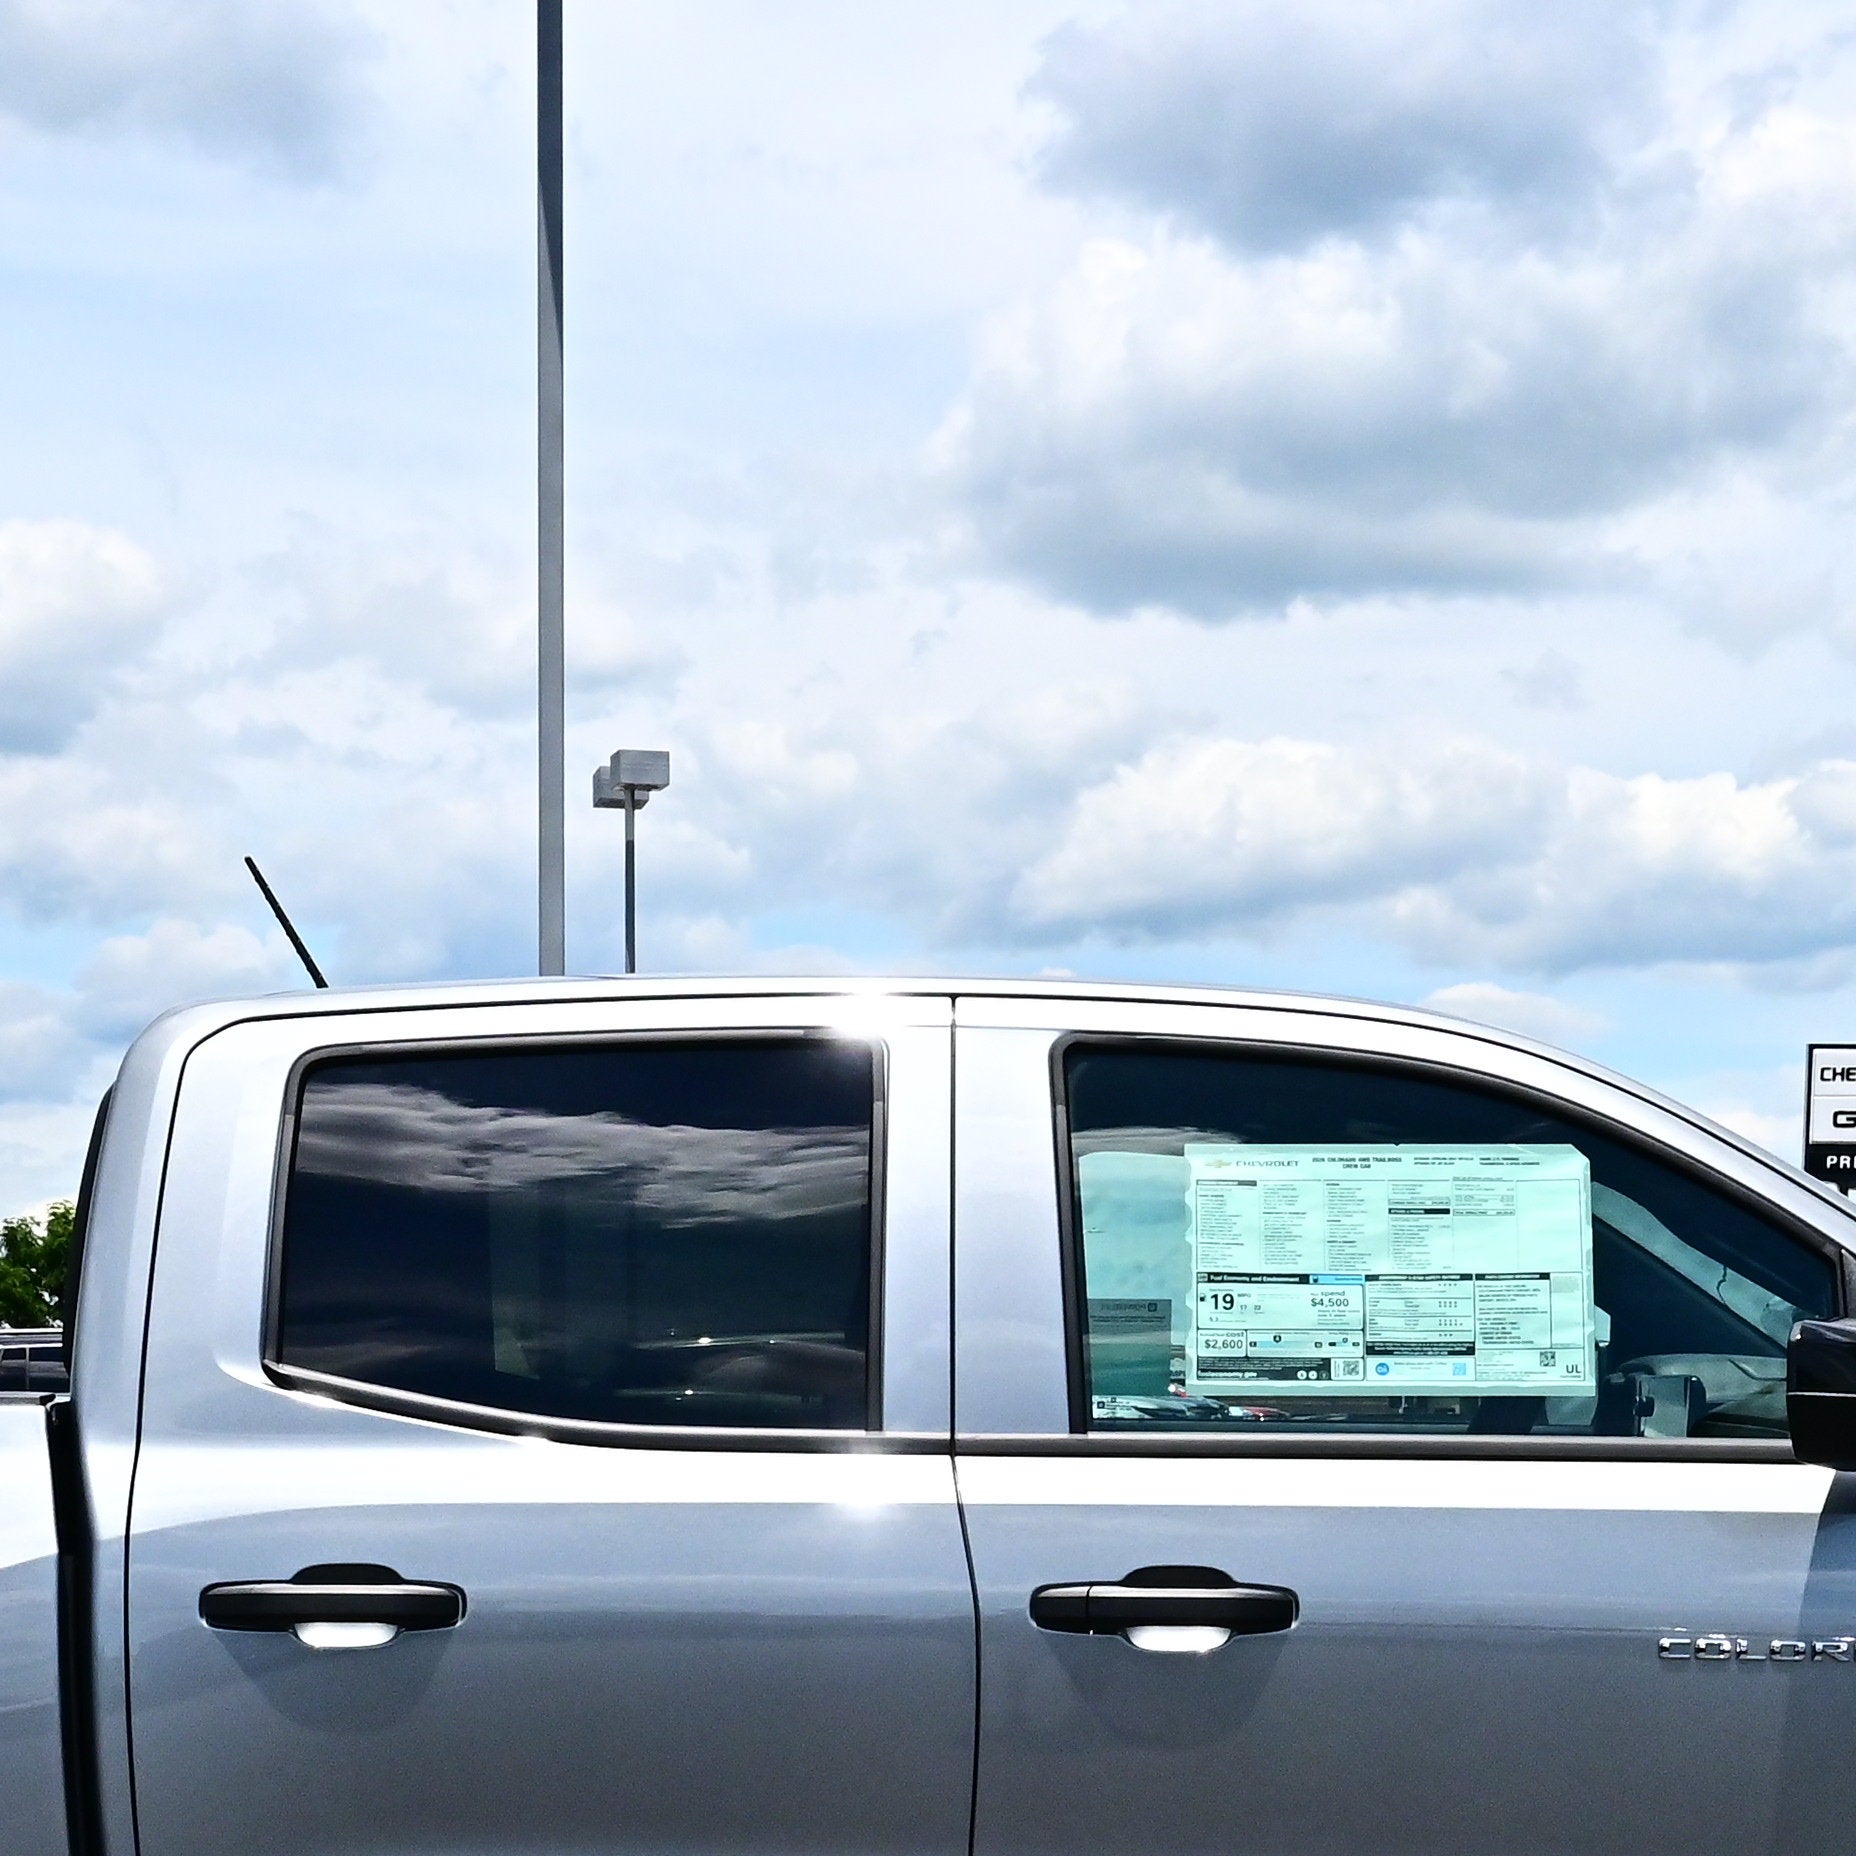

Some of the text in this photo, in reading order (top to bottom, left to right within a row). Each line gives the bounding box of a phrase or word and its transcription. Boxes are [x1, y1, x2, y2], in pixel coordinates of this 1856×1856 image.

[1210, 1293, 1235, 1311] 19
[1310, 1298, 1349, 1308] $4,500
[1204, 1339, 1244, 1350] $2,600
[1565, 1364, 1582, 1374] UL
